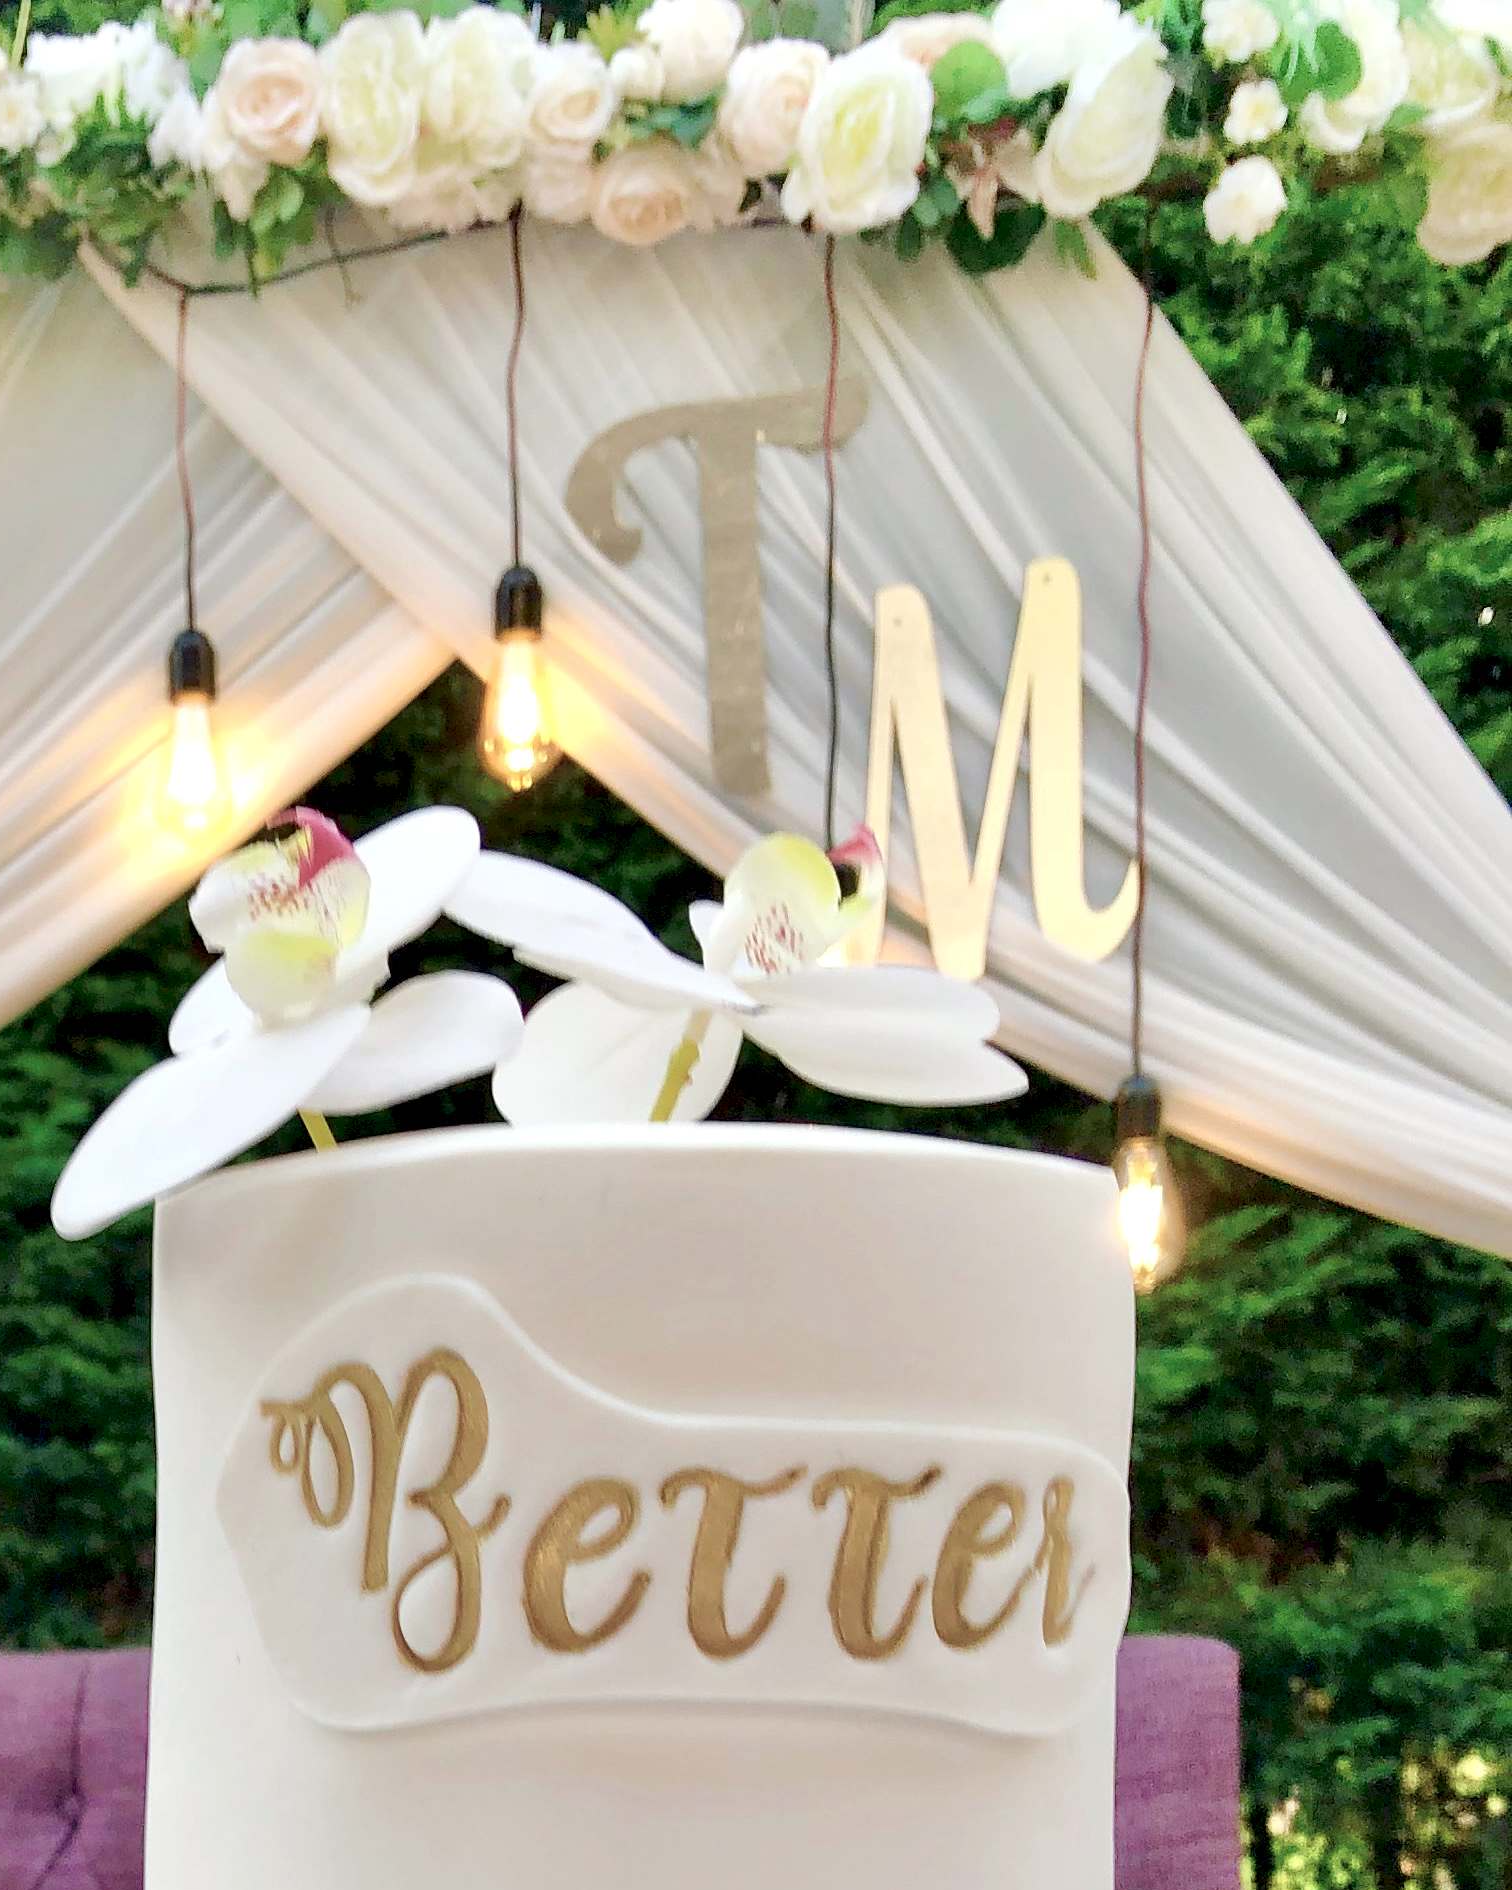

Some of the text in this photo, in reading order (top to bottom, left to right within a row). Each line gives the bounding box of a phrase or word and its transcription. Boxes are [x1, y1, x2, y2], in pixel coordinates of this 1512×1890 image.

[565, 376, 1140, 982] T M
[259, 1346, 1093, 1674] Better
